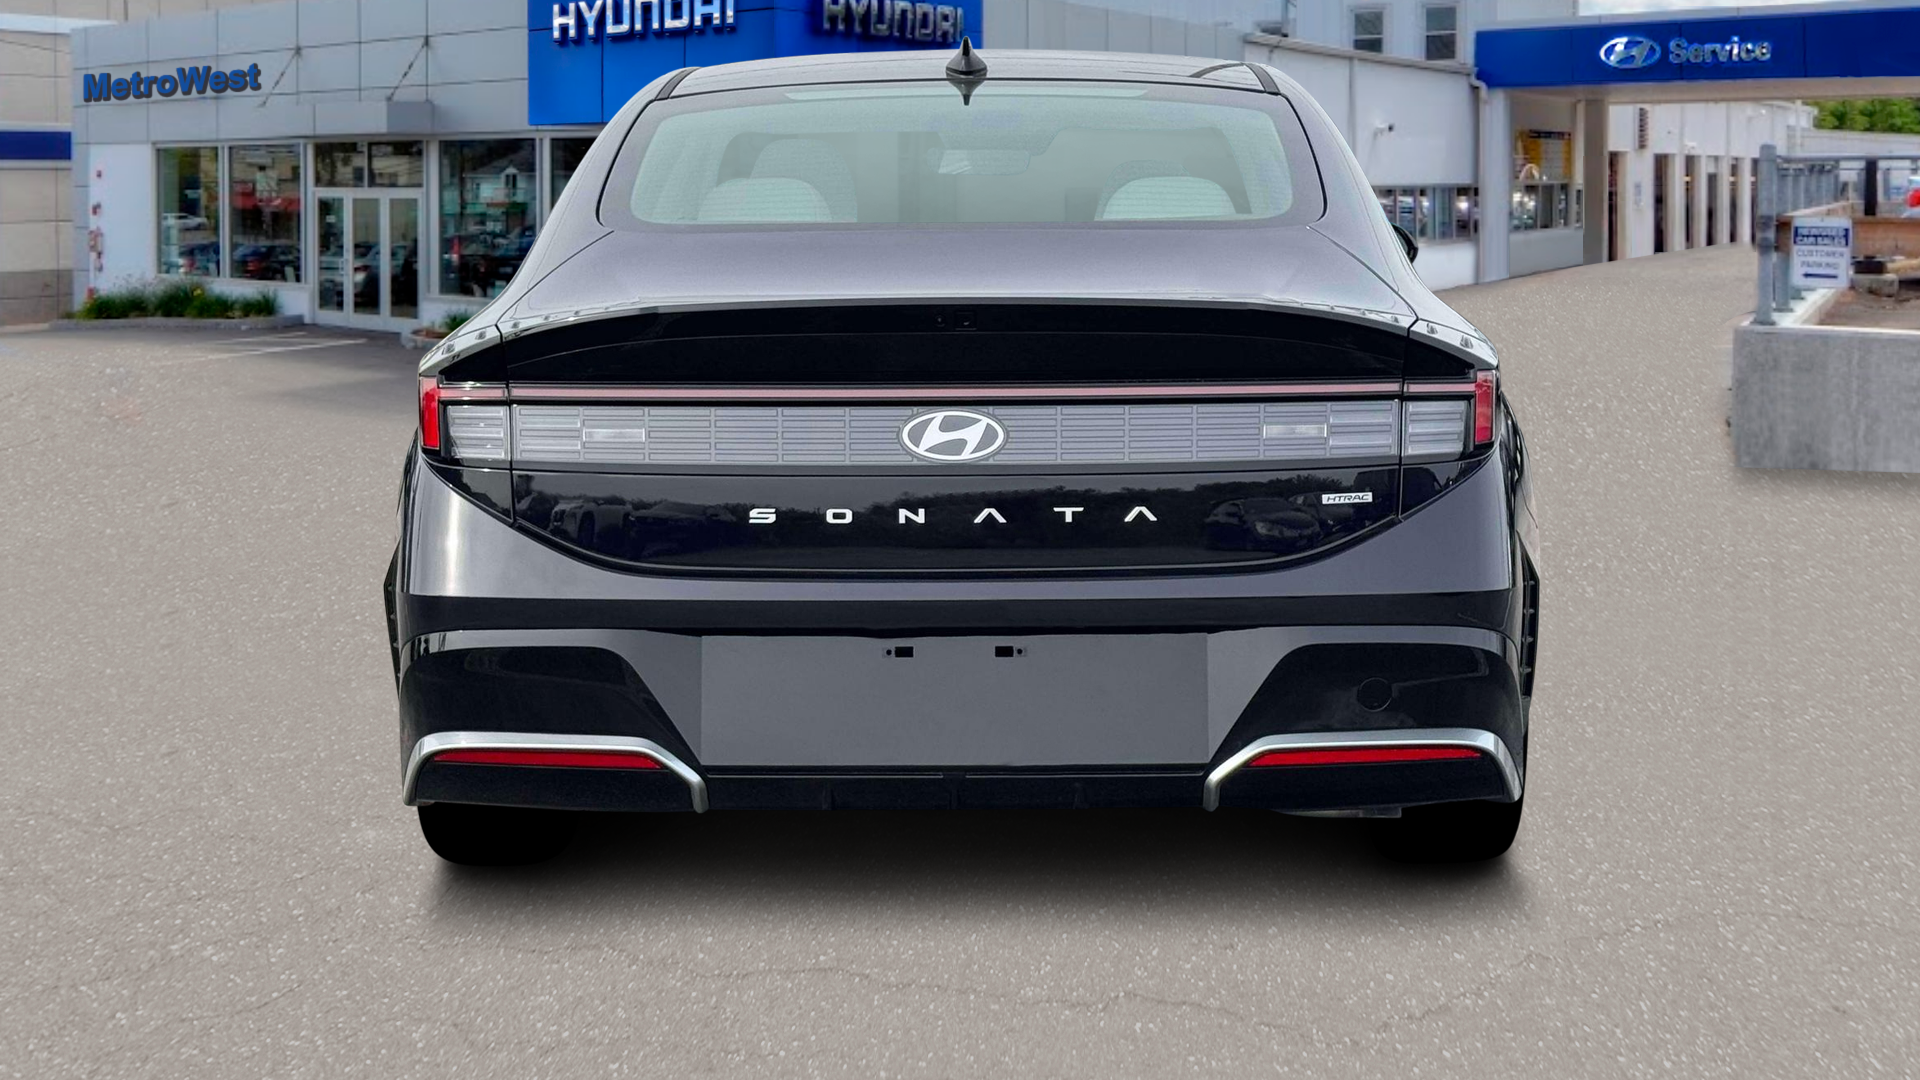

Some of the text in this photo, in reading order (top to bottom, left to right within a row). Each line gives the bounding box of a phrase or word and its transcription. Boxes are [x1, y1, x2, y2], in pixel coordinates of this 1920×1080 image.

[552, 0, 736, 40] HYUNDAI
[823, 0, 965, 42] HYUNDAI
[1669, 35, 1772, 64] Service
[83, 63, 262, 102] MetroWest
[748, 506, 1158, 524] SONATA
[1326, 493, 1370, 503] HTRAC
